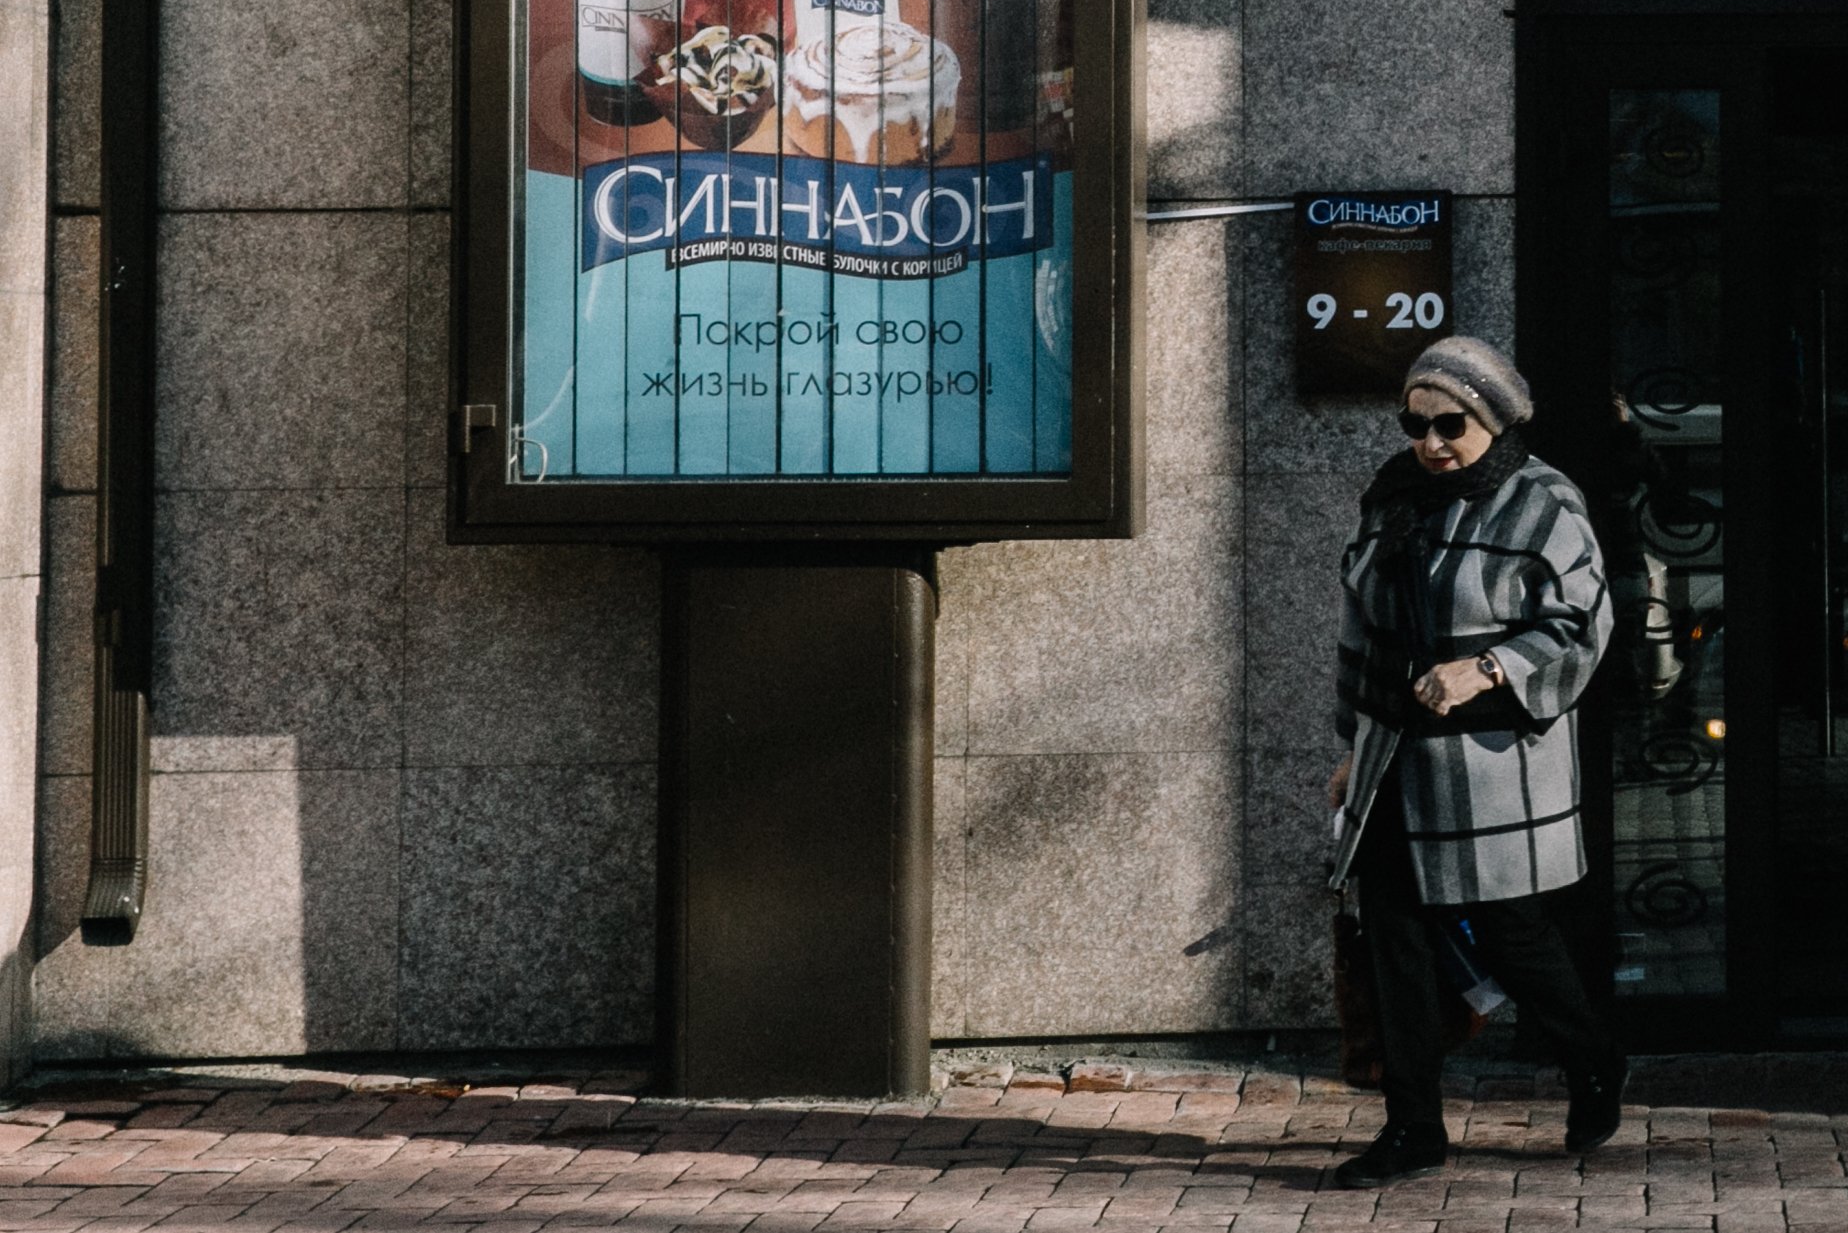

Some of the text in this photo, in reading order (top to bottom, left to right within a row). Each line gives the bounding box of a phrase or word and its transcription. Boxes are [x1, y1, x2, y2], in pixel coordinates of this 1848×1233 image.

[594, 166, 1035, 247] СИННАБОН
[1307, 199, 1439, 224] СИННАБОН
[1306, 293, 1337, 329] 9
[1385, 292, 1444, 329] 20
[675, 312, 963, 353] Покрой свою
[641, 363, 994, 403] жизнь глазурью!
